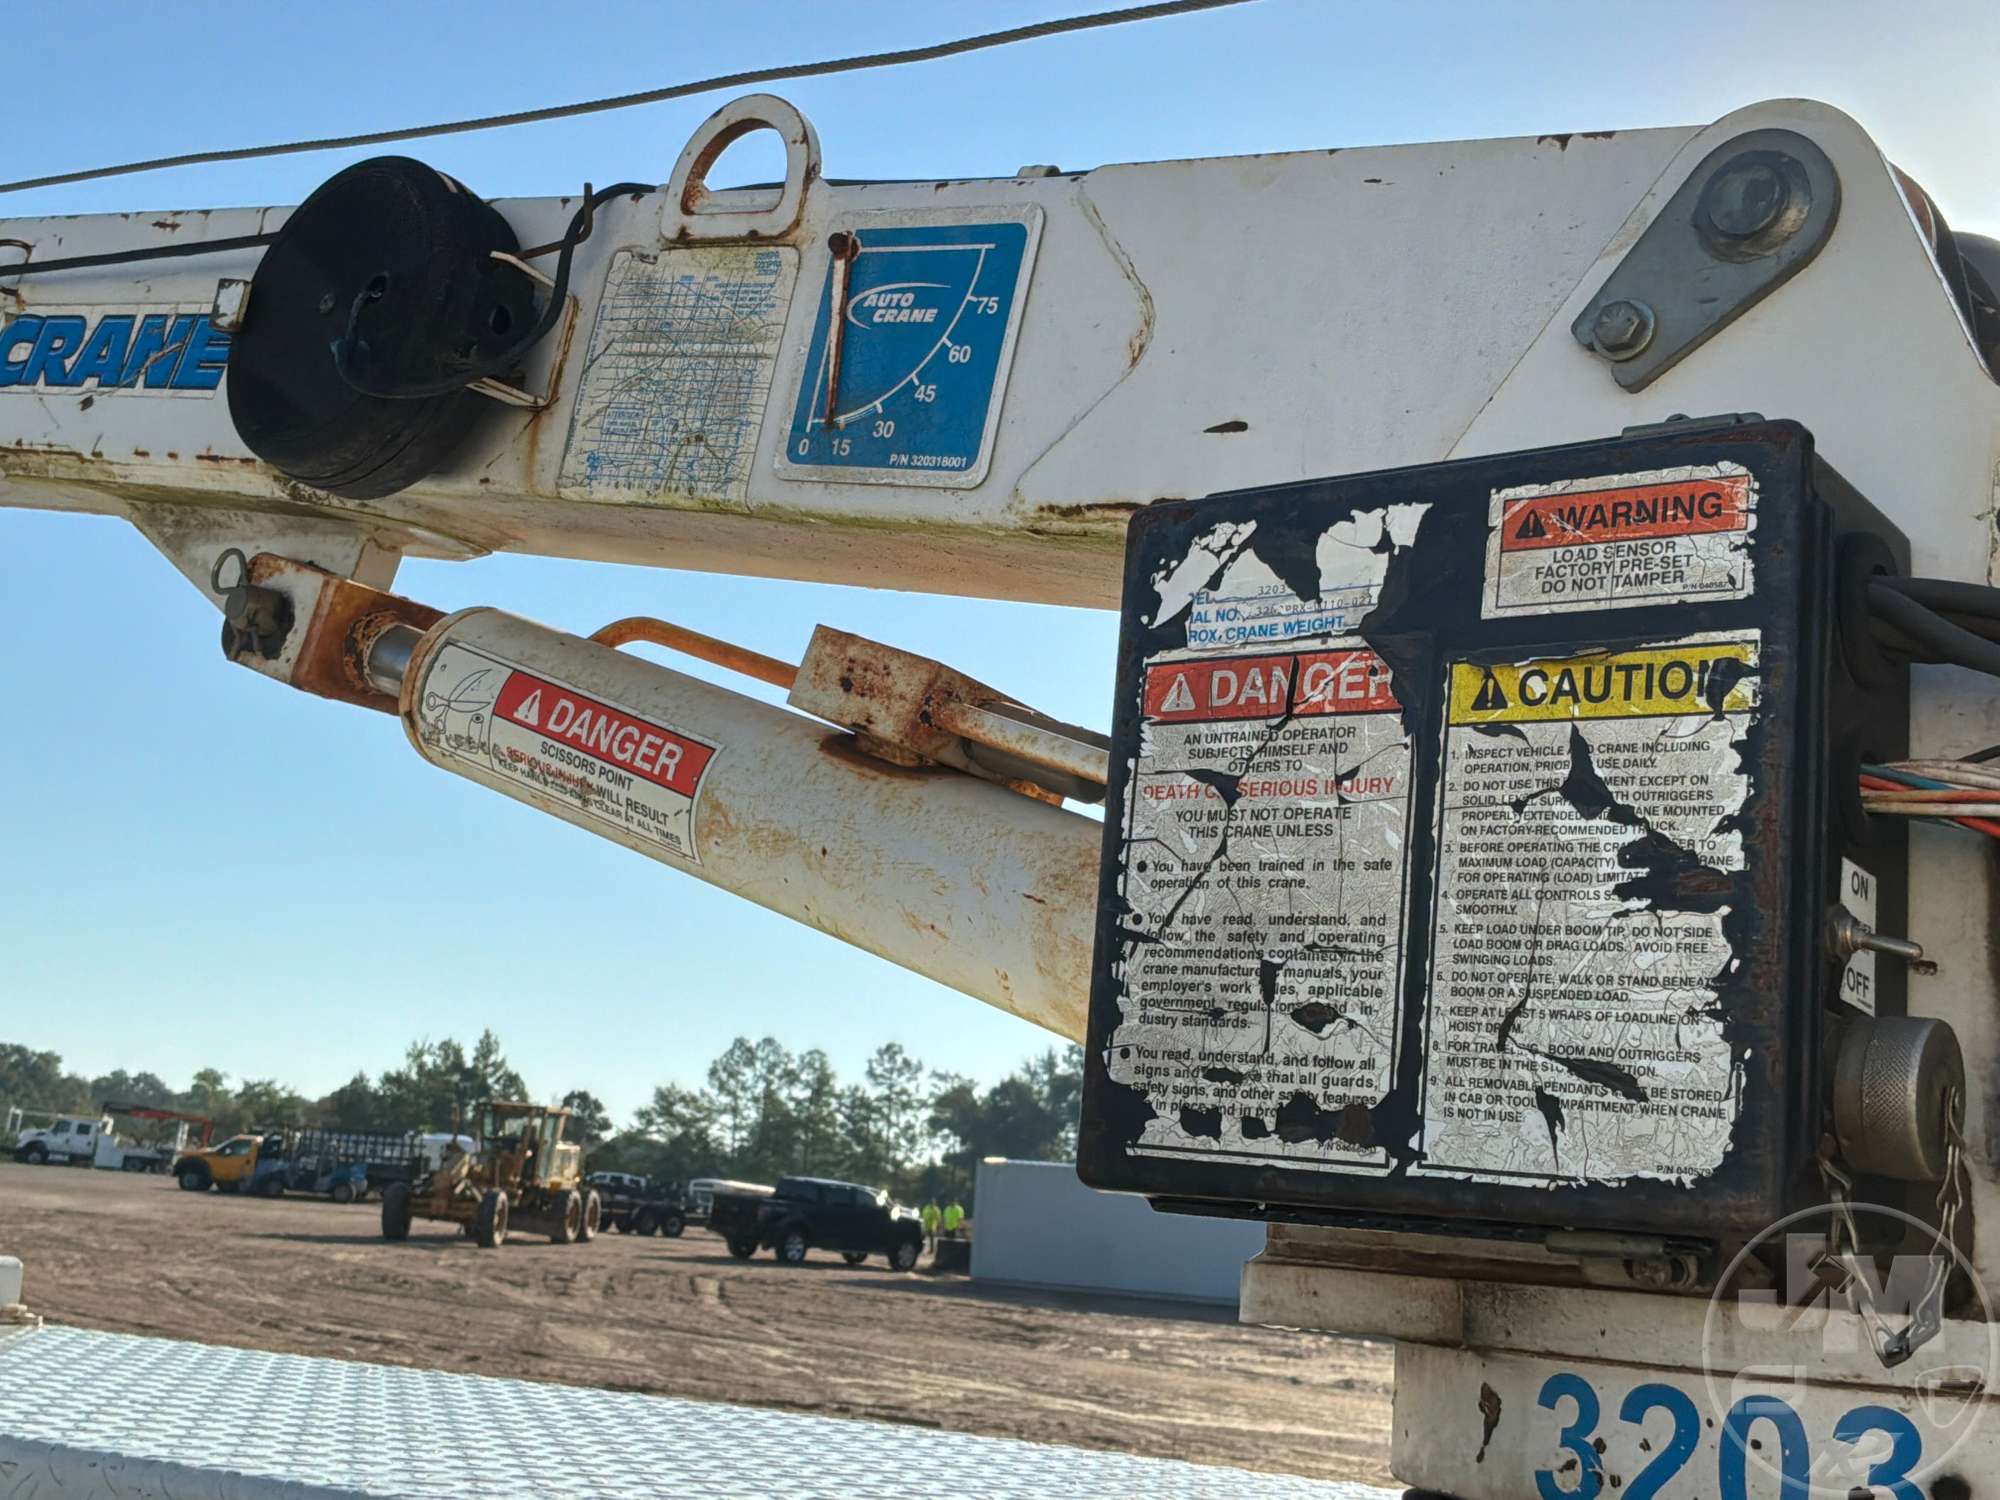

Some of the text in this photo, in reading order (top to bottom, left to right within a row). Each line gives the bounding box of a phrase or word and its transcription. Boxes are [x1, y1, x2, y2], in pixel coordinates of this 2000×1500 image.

[863, 293, 938, 323] AUTO CRANE
[976, 297, 999, 314] 75
[0, 313, 233, 390] CRANE
[949, 346, 971, 363] 60
[914, 385, 936, 402] 45
[873, 421, 894, 438] 30
[798, 439, 850, 455] 0 15
[889, 454, 968, 467] P/N 320318001
[1558, 492, 1723, 531] WARNING
[1553, 541, 1676, 564] LOAD SENSOR
[1536, 555, 1693, 580] FACTORY PRE-SET
[1258, 584, 1286, 595] 3203
[1542, 571, 1684, 593] DO NOT TAMPER
[1226, 623, 1279, 640] CRANE
[1284, 616, 1345, 634] WEIGHT
[547, 698, 685, 782] DANGER
[1205, 727, 1355, 743] UNTRAINED OPERATOR
[1188, 741, 1348, 759] SUBJECTS AND
[1517, 746, 1564, 757] VEHICLE
[1597, 743, 1638, 753] CRANE
[1642, 741, 1710, 752] INCLUDING
[540, 741, 595, 775] SCISSORS
[599, 766, 634, 791] POINT
[1228, 760, 1281, 772] OTHERS
[1465, 759, 1620, 774] OPERATION, USE
[1144, 785, 1198, 800] DEATH
[1238, 780, 1317, 797] SERIOUS
[1483, 781, 1504, 790] NOT
[1509, 780, 1531, 789] USE
[1536, 779, 1560, 788] THIS
[1640, 776, 1687, 786] EXCEPT
[1633, 790, 1713, 801] OUTRIGGERS
[595, 784, 622, 807] WILL
[626, 798, 669, 826] RESULT
[1663, 806, 1724, 816] MOUNTED
[1176, 807, 1351, 822] YOU MUST NOT OPERATE
[1189, 824, 1333, 838] THIS CRANE UNLESS
[1480, 826, 1628, 836] FACTORY-RECOMMENDED
[1460, 843, 1504, 852] BEFORE
[1508, 842, 1573, 852] OPERATING
[1579, 842, 1600, 852] THE
[1152, 859, 1392, 873] You have been trained the safe
[1459, 857, 1615, 869] MAXIMUM LOAD (CAPACITY)
[1237, 876, 1310, 888] this crane.
[1458, 872, 1592, 885] FOR OPERATING (LOAD)
[1851, 871, 1869, 900] ON
[1456, 890, 1507, 899] OPERATE
[1512, 890, 1532, 899] ALL
[1535, 890, 1600, 900] CONTROLS
[1456, 904, 1517, 915] SMOOTHLY.
[1182, 913, 1386, 927] have read, understand, and
[1195, 930, 1385, 947] the safety and operating
[1454, 924, 1712, 937] KEEP LOAD UNDER BOOM NOT SIDE
[1453, 939, 1708, 953] LOAD BOOM DRAG LOADS. AVOID FREE
[1452, 955, 1554, 965] SWINGING LOADS.
[1143, 964, 1383, 981] crane your
[1471, 972, 1659, 986] NOT OPERATE, WALK STAND
[1141, 979, 1383, 999] employer's work applicable
[1846, 967, 1870, 999] OFF
[1450, 987, 1631, 1002] BOOM LOAD.
[1139, 1013, 1177, 1028] dustry
[1450, 1007, 1677, 1024] KEEP WRAPS LOADLINE
[1449, 1022, 1482, 1032] HOIST
[1136, 1046, 1375, 1070] You read, understand, and follow all
[1447, 1041, 1700, 1063] FOR BOOM OUTRIGGERS
[1446, 1057, 1479, 1068] MUST
[1134, 1064, 1378, 1090] signs all guards,
[1172, 1082, 1274, 1100] signs, and other
[1544, 1082, 1722, 1101] PENDANTS STORED
[1640, 1104, 1727, 1119] WHEN CRANE
[1535, 1373, 1923, 1500] 3203
